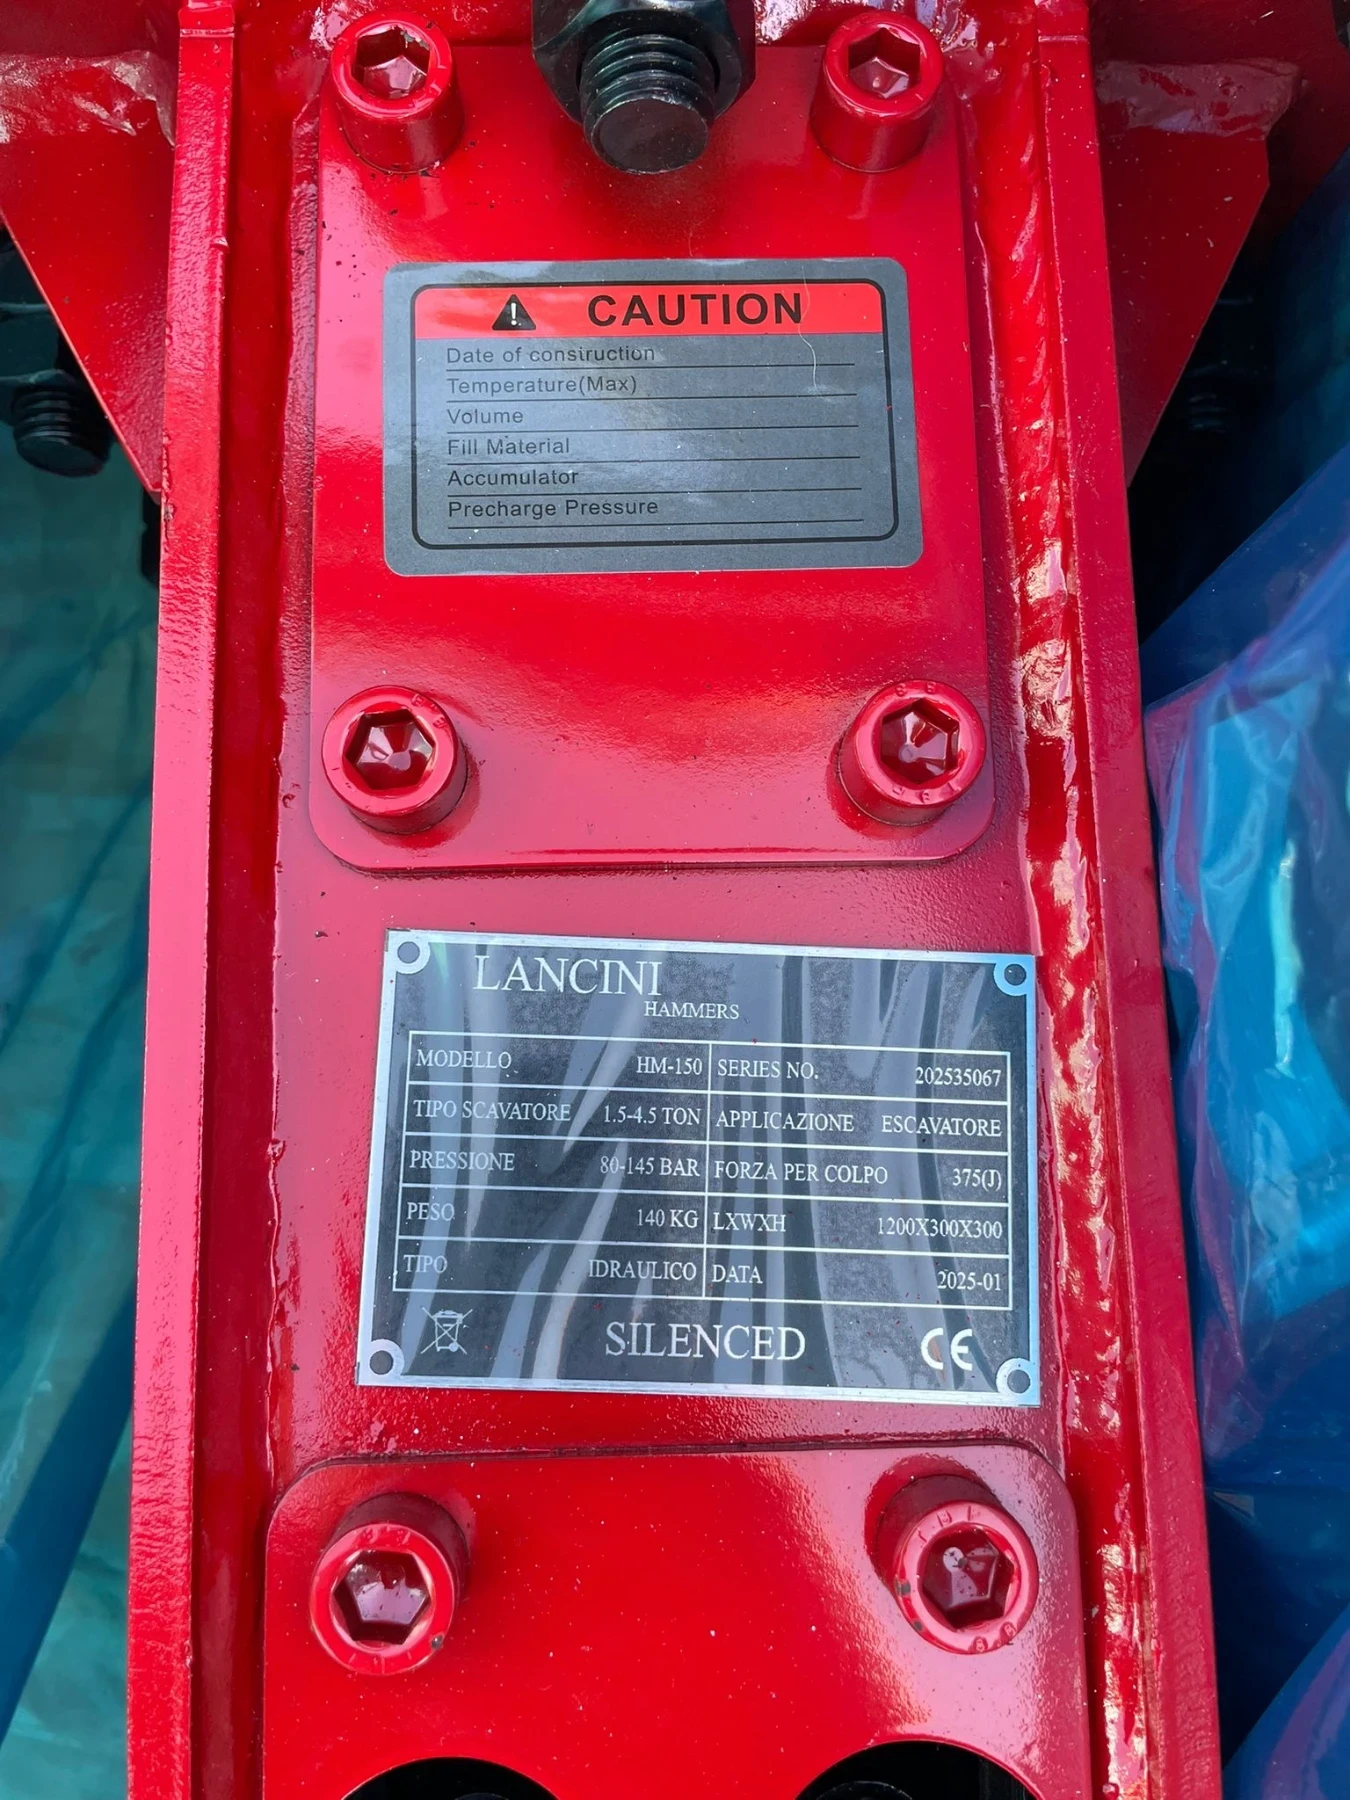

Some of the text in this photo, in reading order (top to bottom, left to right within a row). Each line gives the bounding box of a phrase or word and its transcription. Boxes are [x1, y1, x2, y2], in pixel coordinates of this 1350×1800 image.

[587, 292, 802, 327] CAUTION
[447, 345, 655, 364] Date of construction
[447, 376, 637, 396] Temperature(Max)
[447, 409, 524, 424] Volume
[447, 437, 570, 455] Fill Material
[447, 469, 578, 486] Accumulator
[448, 499, 659, 521] Precharge Pressure
[473, 956, 663, 995] LANCINI
[643, 1001, 740, 1020] HAMMERS
[417, 1049, 511, 1069] MODELLO
[636, 1057, 703, 1075] HM-150
[717, 1060, 819, 1079] SERIES NO.
[915, 1066, 1001, 1086] 202535067
[414, 1100, 572, 1122] TIPO SCAVATORE
[604, 1105, 701, 1125] 1.5-4.5 TON
[716, 1111, 855, 1132] APPLICAZIONE
[881, 1116, 1002, 1136] ESCAVATORE
[410, 1149, 515, 1171] PRESSIONE
[600, 1156, 700, 1176] 80-145 BAR
[714, 1163, 888, 1184] FORZA PER COLPO
[953, 1168, 1002, 1190] 375(J)
[406, 1202, 455, 1220] PESO
[637, 1209, 699, 1228] 140 KG
[713, 1212, 786, 1232] LXWXH
[878, 1218, 1002, 1239] 1200X300X300
[404, 1255, 447, 1272] TIPO
[589, 1260, 697, 1280] IDRAULICO
[712, 1265, 763, 1284] DATA
[937, 1271, 1002, 1291] 2025-01
[605, 1322, 806, 1362] SILENCED
